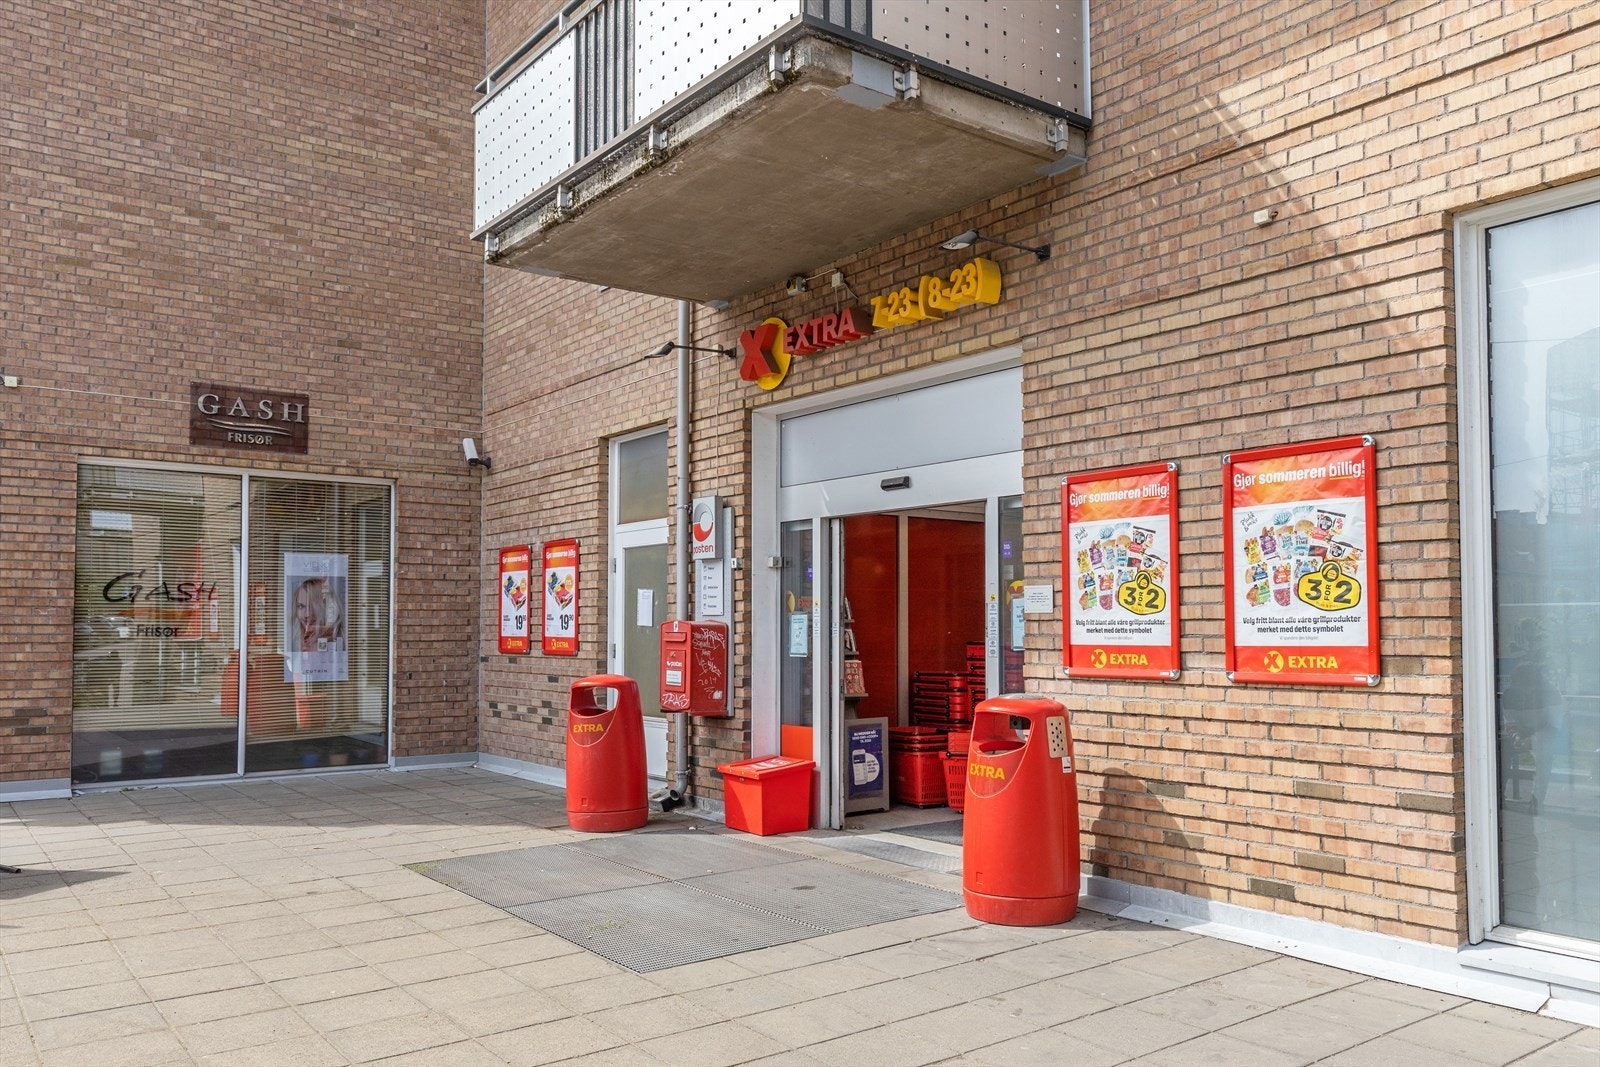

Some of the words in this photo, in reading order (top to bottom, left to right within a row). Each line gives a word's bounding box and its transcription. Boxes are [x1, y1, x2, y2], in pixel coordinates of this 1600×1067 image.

[870, 287, 917, 329] 7-23
[783, 307, 867, 355] EXTRA
[197, 393, 305, 423] GASH
[227, 432, 273, 445] FRISØR
[1233, 473, 1256, 490] Gjør
[1258, 466, 1326, 485] sommeren
[1329, 460, 1365, 478] billig!
[1070, 493, 1087, 507] Gjør
[1089, 488, 1141, 503] sommeren
[1142, 482, 1170, 499] billig!
[102, 569, 217, 602] GASH
[1305, 578, 1322, 601] 3
[1324, 584, 1332, 601] FOR
[1333, 580, 1353, 604] 2
[1123, 586, 1137, 606] 3
[1145, 588, 1160, 610] 2
[515, 614, 523, 630] 19
[560, 614, 569, 630] 19
[1243, 617, 1255, 625] Velg
[1255, 616, 1268, 624] fritt
[1268, 616, 1285, 624] blant
[1297, 616, 1312, 624] våre
[1313, 615, 1361, 625] grillprodukter
[1103, 626, 1114, 634] med
[1128, 627, 1152, 635] symbolet
[1279, 625, 1294, 633] med
[1294, 625, 1312, 633] dette
[1312, 625, 1344, 634] symbolet
[1110, 653, 1149, 665] EXTRA
[1288, 656, 1338, 669] EXTRA
[573, 723, 604, 733] EXTRA
[969, 762, 1005, 780] EXTRA
